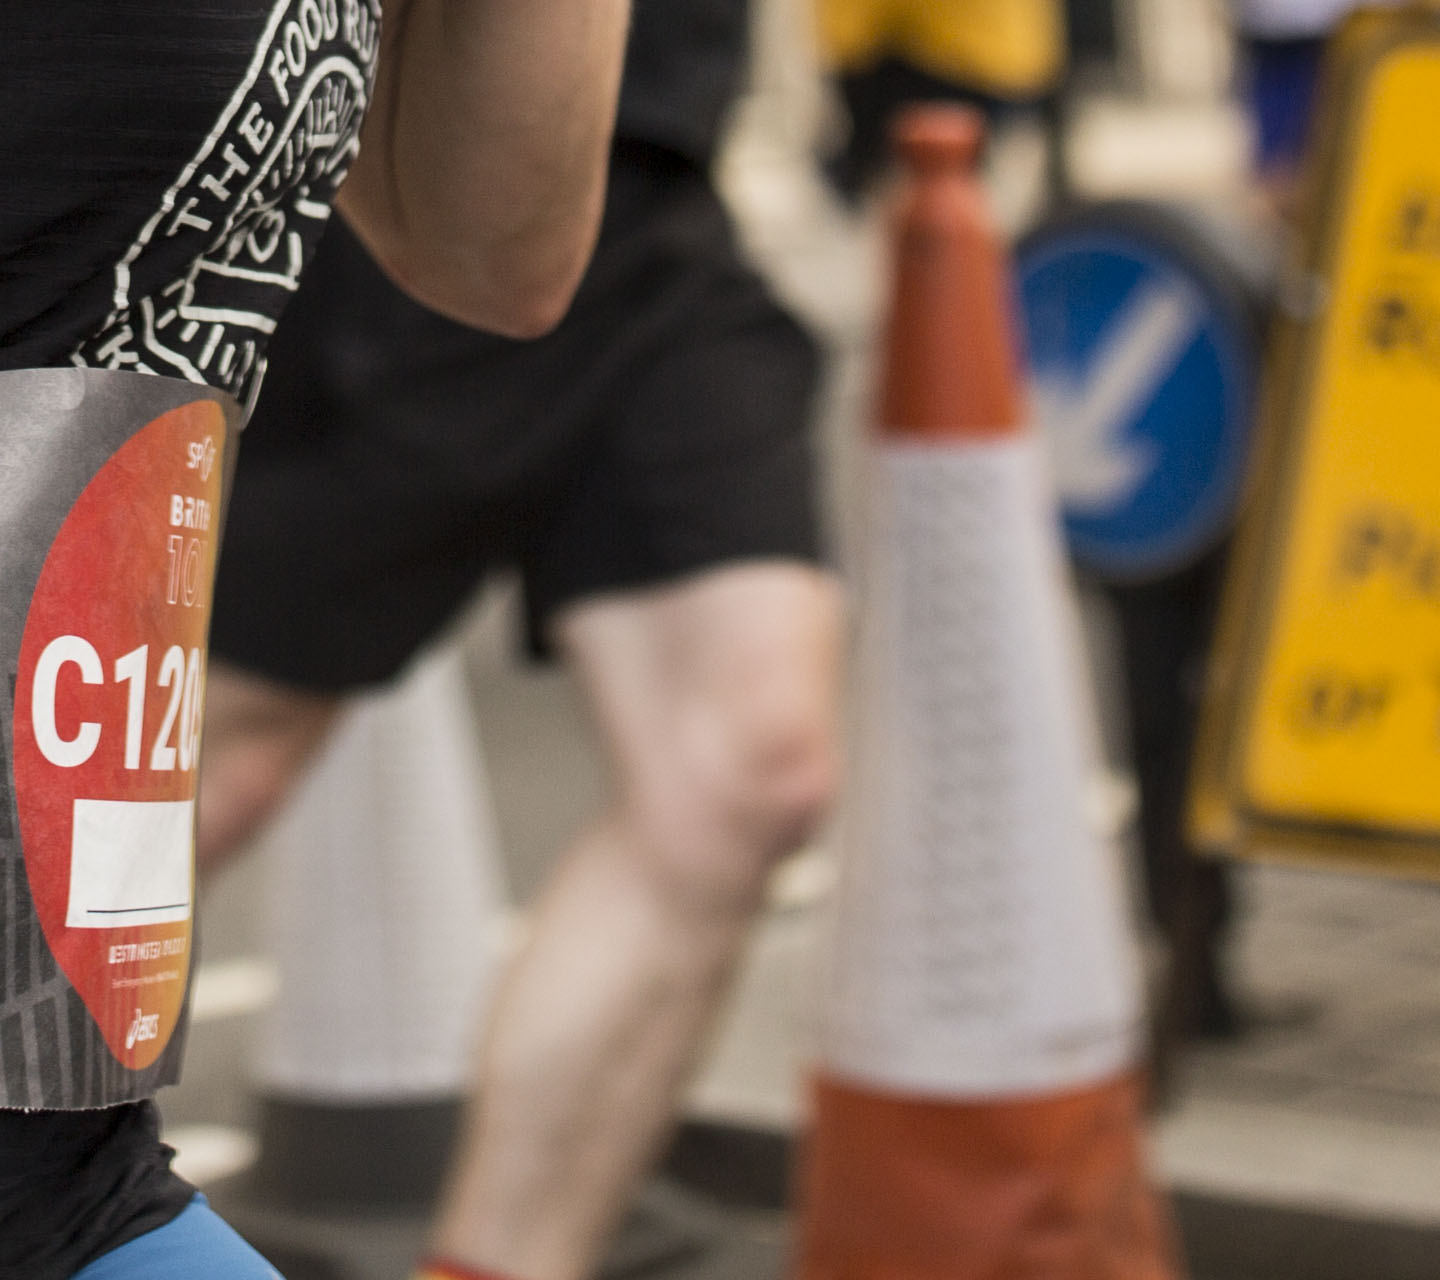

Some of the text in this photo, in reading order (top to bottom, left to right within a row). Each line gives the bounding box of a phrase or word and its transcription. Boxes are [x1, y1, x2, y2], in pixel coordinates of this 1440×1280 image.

[166, 101, 274, 237] THE
[166, 534, 207, 608] 10
[1287, 666, 1390, 744] or
